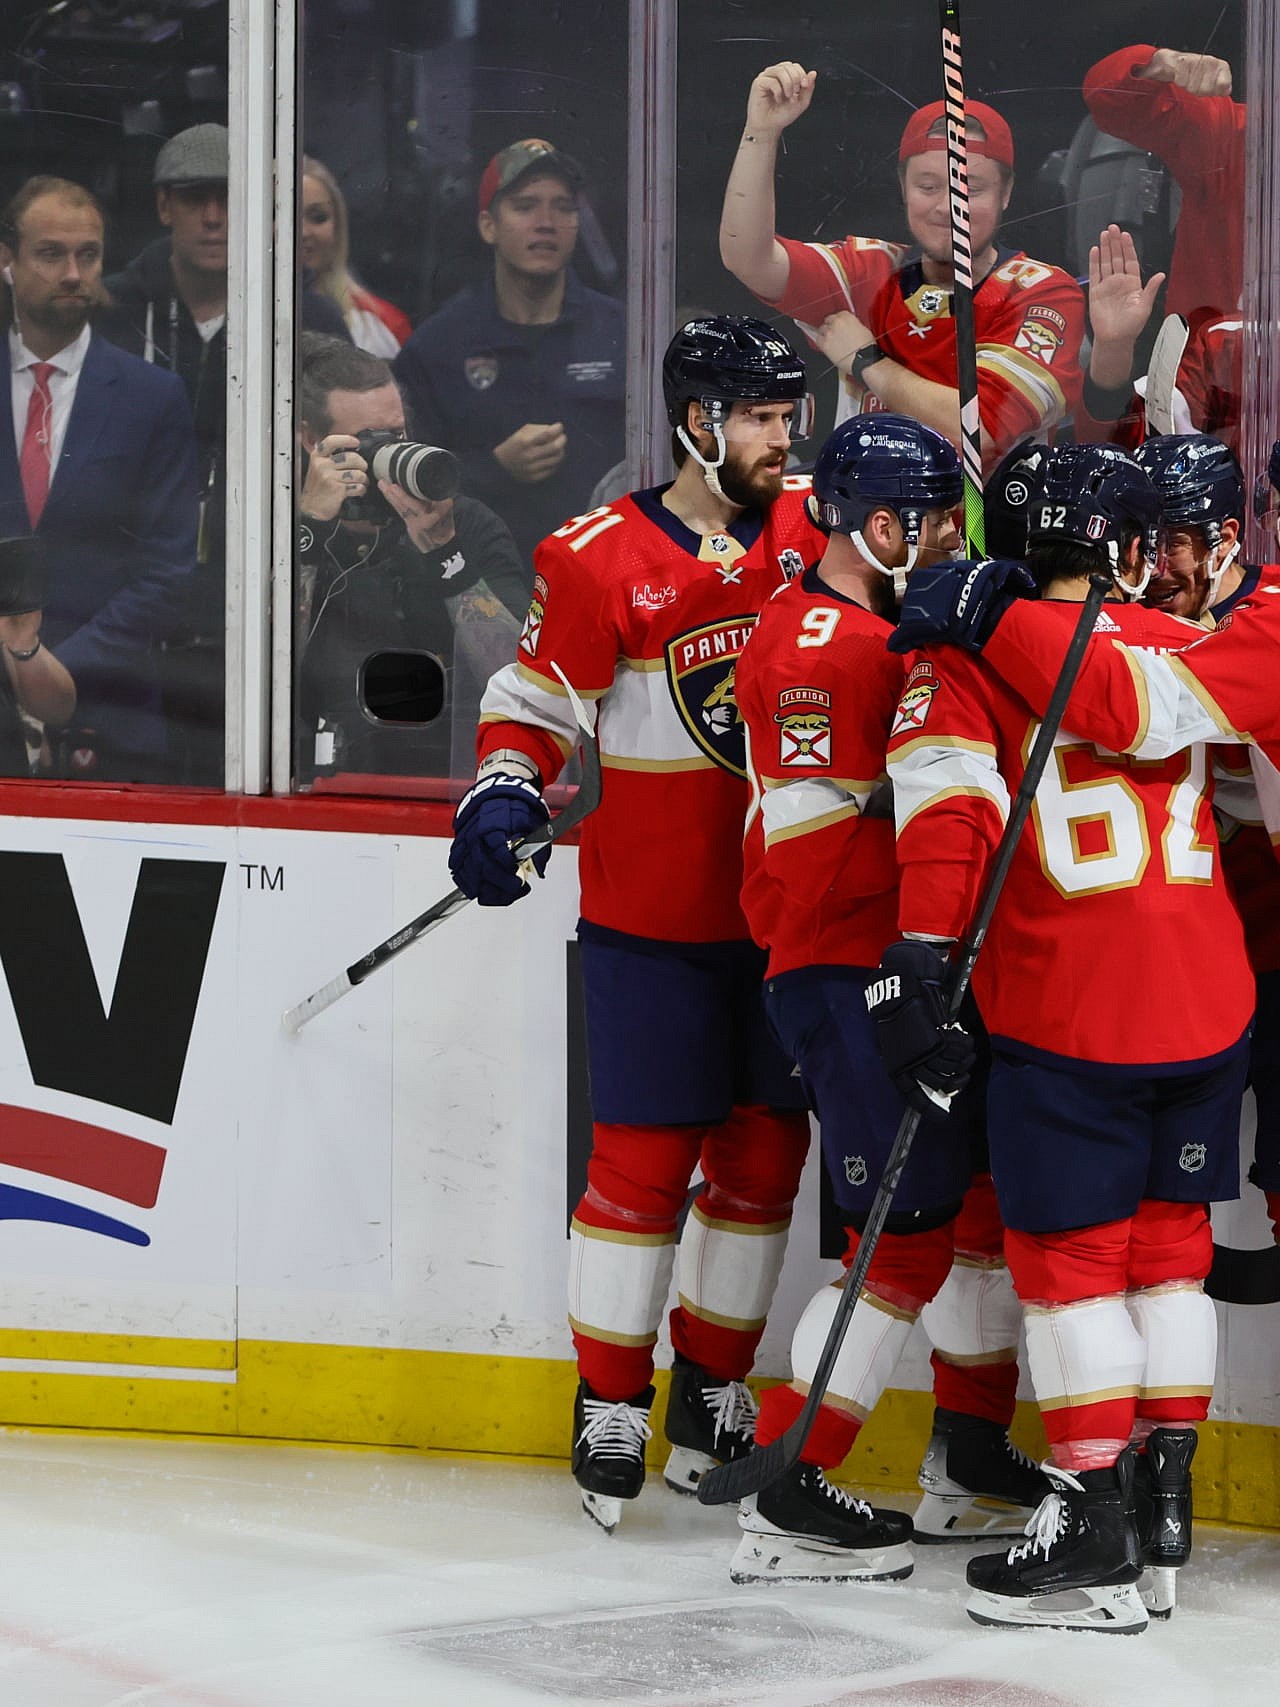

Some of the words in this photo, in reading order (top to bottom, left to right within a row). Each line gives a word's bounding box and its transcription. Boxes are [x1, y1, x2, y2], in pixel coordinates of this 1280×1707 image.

[942, 27, 973, 291] WARRIOR
[764, 340, 790, 358] 91
[872, 440, 917, 450] LAUDERDALE
[552, 506, 625, 553] 91
[1040, 506, 1067, 529] 62
[796, 606, 842, 649] 9
[785, 691, 825, 702] FLORIDA
[1020, 716, 1215, 900] 62
[239, 864, 284, 891] TM
[864, 975, 901, 1012] IOR
